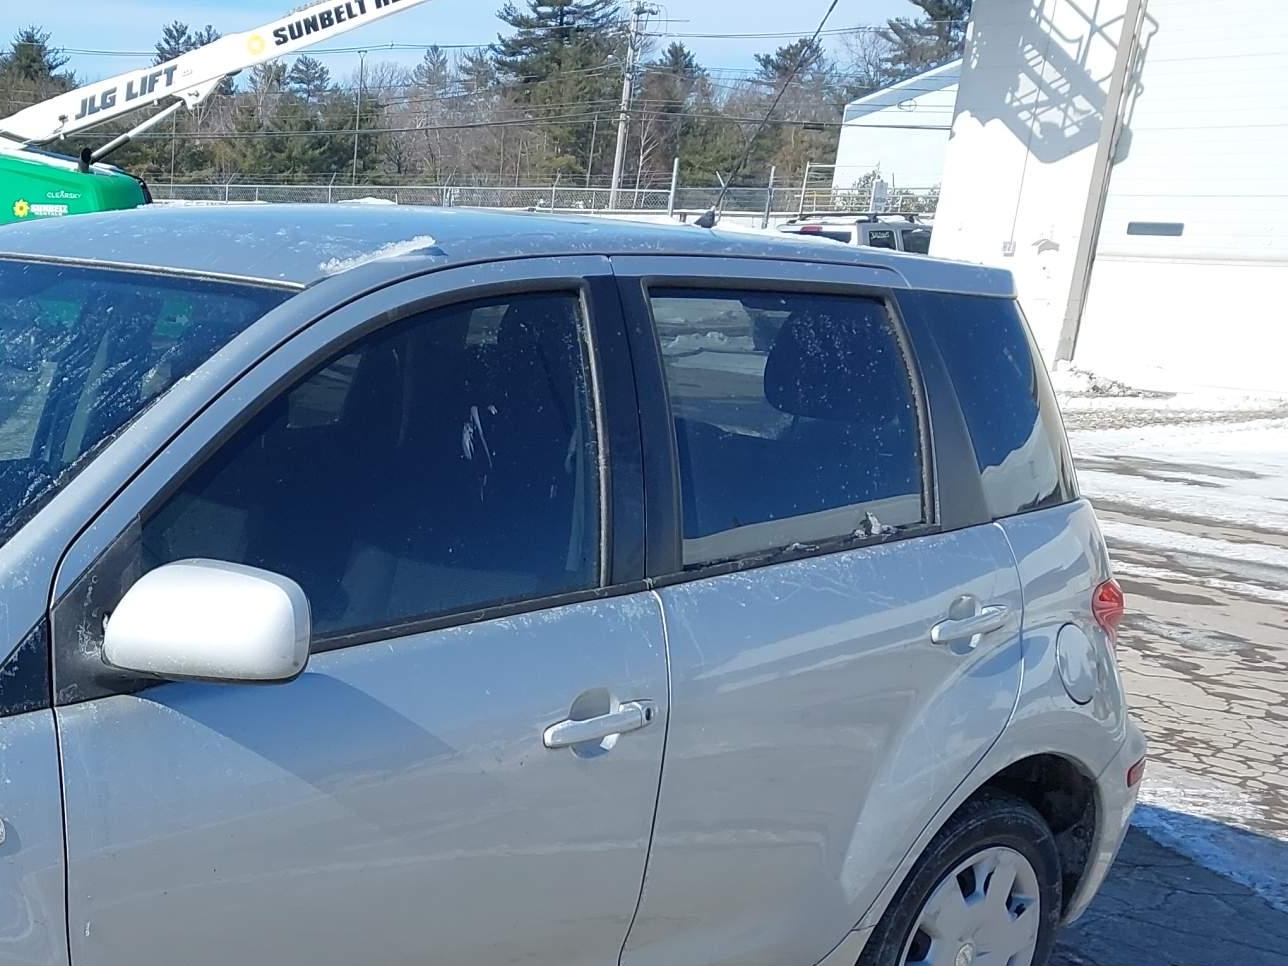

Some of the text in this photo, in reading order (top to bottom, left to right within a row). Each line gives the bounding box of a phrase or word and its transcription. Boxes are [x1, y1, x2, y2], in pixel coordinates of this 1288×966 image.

[273, 0, 367, 46] SUNBELT
[75, 64, 178, 120] JLG LIFT
